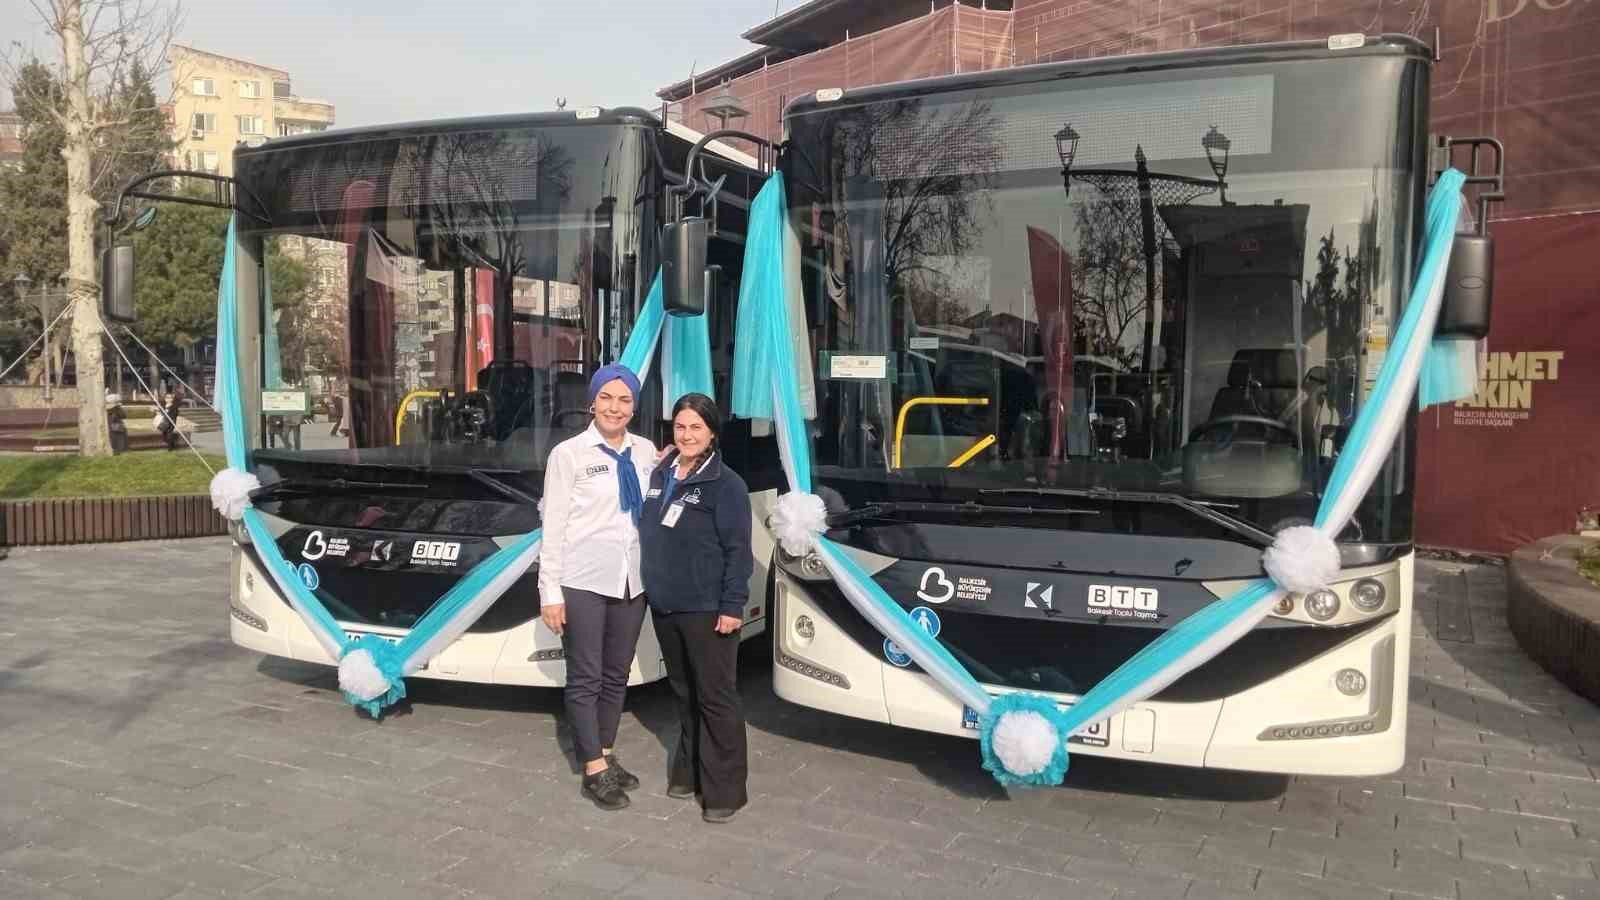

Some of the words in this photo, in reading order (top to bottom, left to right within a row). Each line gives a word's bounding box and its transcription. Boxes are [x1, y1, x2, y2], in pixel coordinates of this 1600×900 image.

[1479, 351, 1564, 380] HMET
[413, 542, 459, 560] BTT
[1091, 586, 1156, 609] BTT
